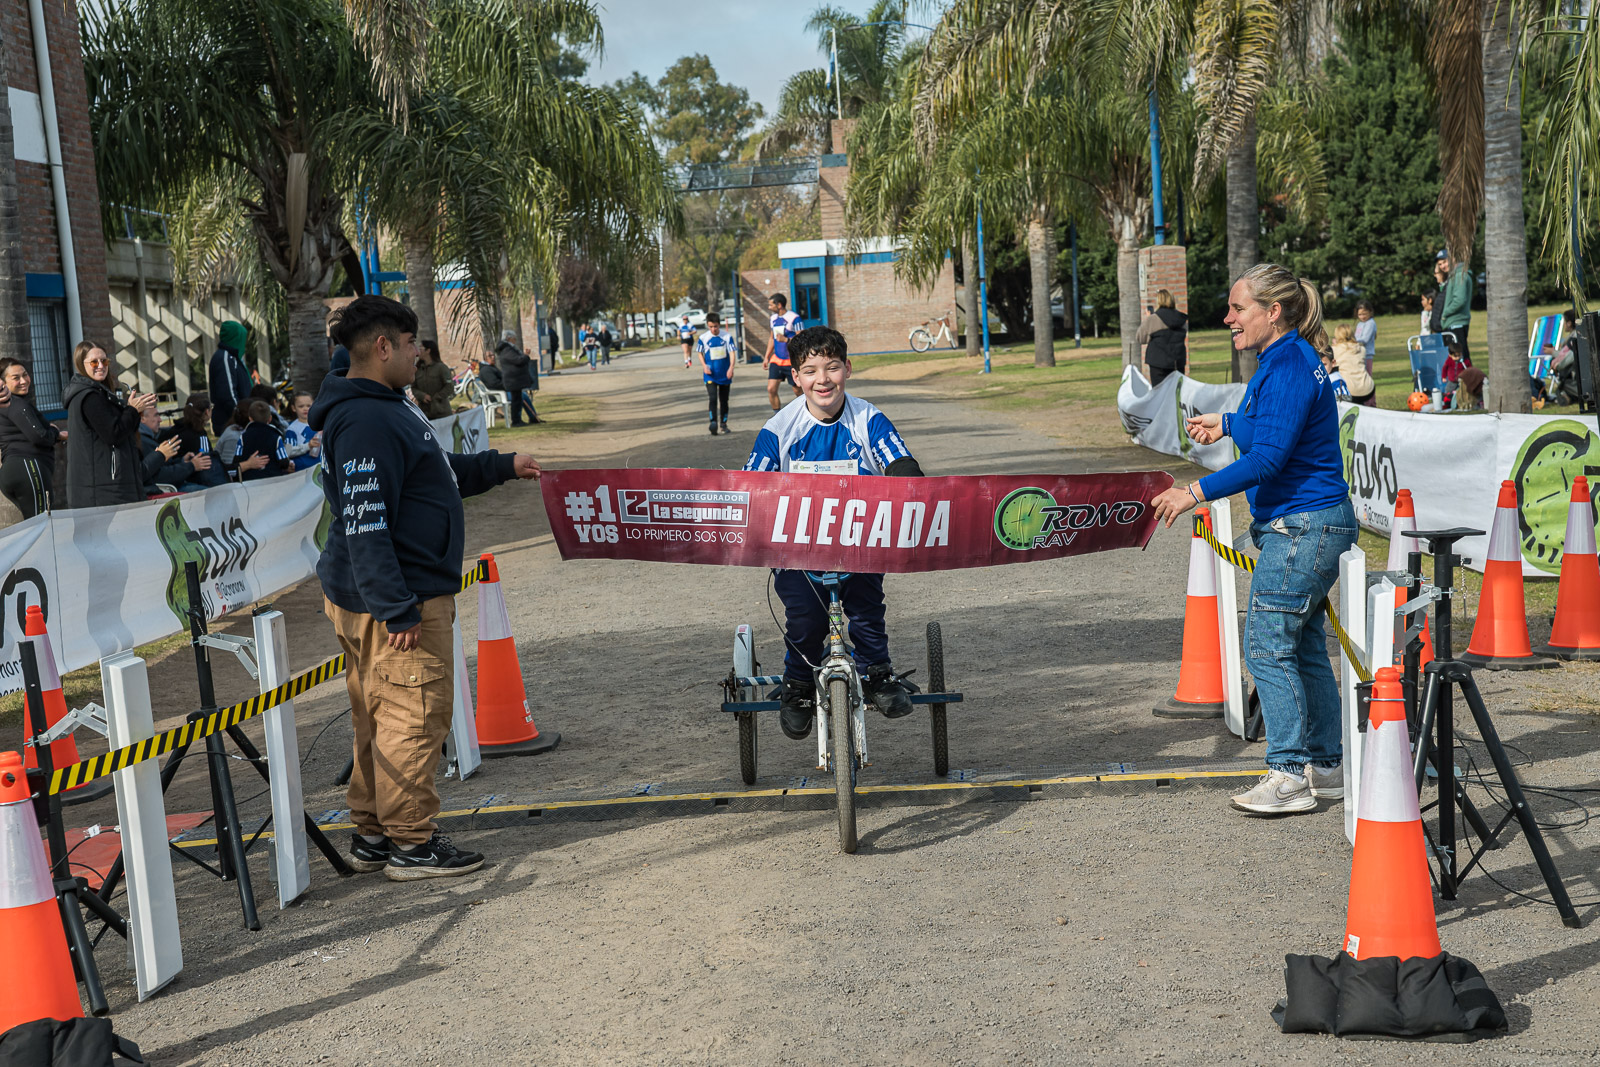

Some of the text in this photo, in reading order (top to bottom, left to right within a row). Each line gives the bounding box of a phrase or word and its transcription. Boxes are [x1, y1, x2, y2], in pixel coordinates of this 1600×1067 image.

[564, 485, 616, 522] #1
[684, 494, 744, 502] ASEGURADOR
[672, 505, 743, 523] segunda
[771, 496, 950, 548] LLEGADA
[573, 524, 619, 543] VOS
[625, 528, 744, 544] LO PRIMERO SOS VOS
[1031, 532, 1077, 549] RAV
